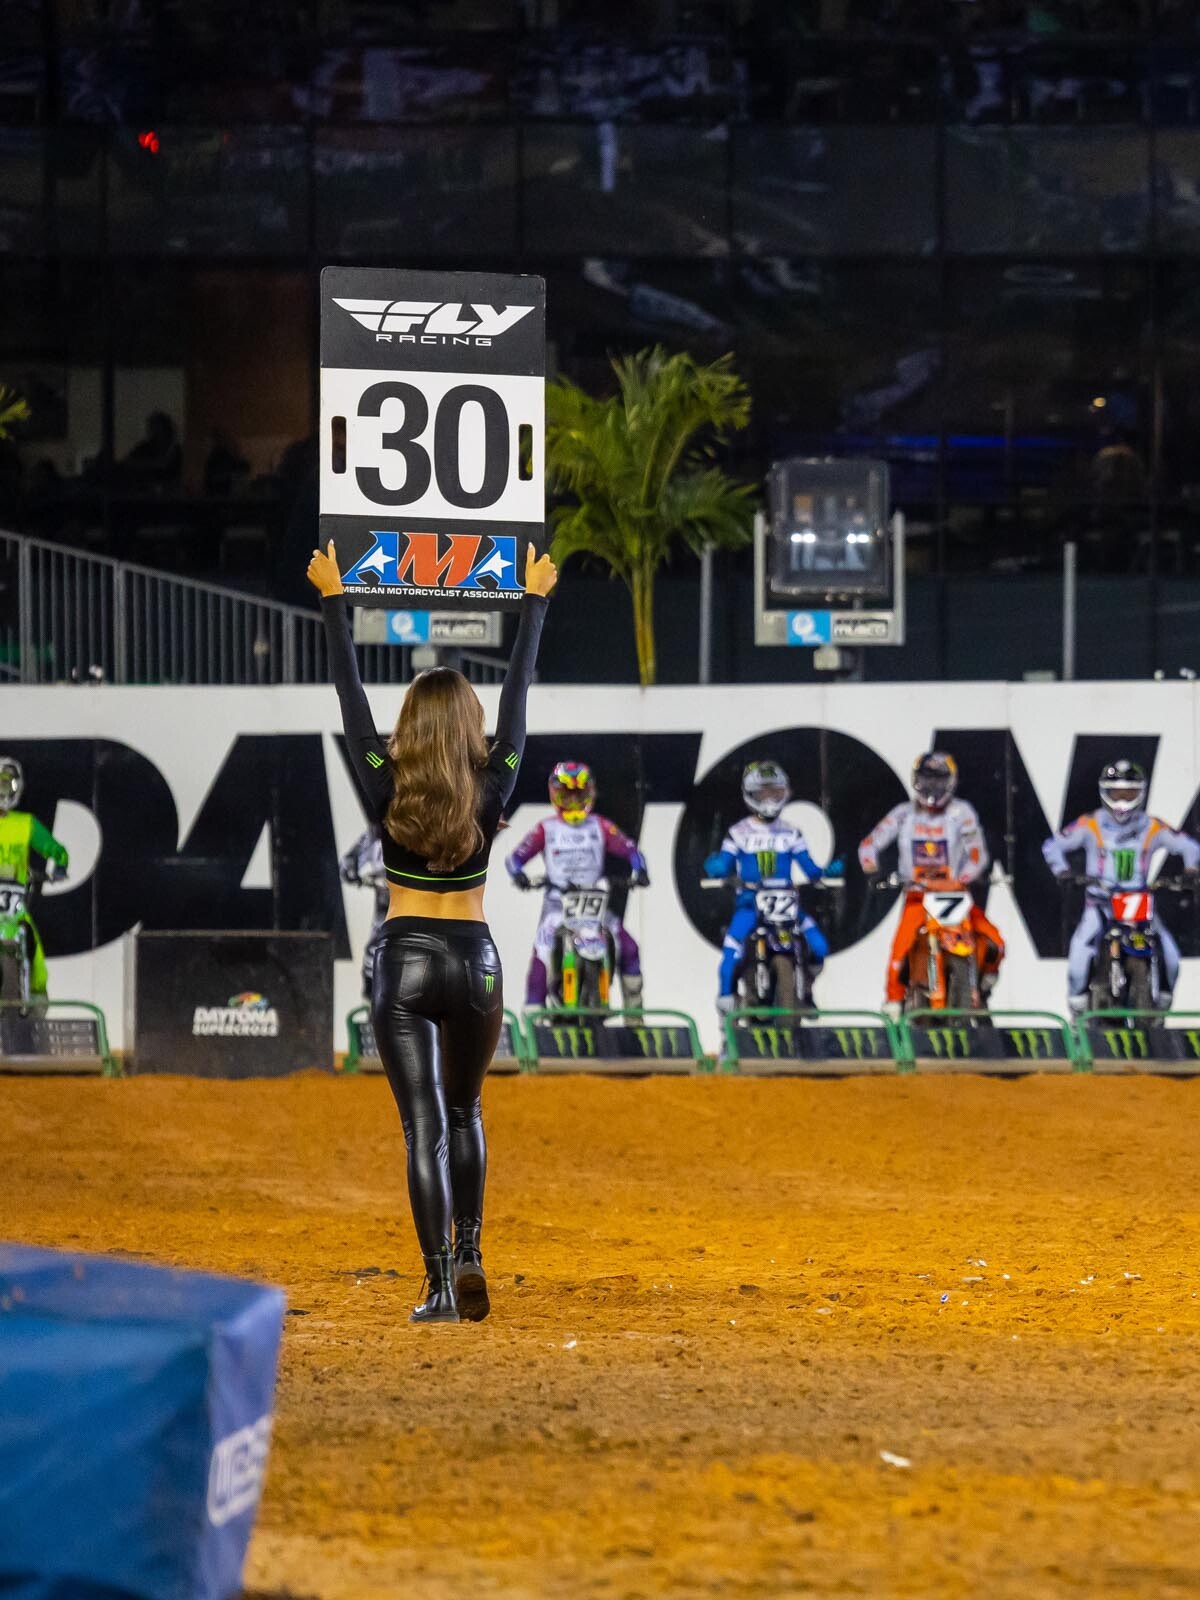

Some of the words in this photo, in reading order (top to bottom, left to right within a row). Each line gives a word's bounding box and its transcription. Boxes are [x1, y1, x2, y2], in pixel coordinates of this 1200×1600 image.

[381, 299, 536, 336] FLY
[375, 333, 493, 347] RACING
[355, 381, 510, 510] 30
[341, 530, 527, 591] AMA
[343, 585, 385, 595] MERICAN
[386, 586, 461, 598] MOTORCYCLIST
[566, 896, 603, 919] 219
[935, 897, 964, 919] 7
[1122, 893, 1143, 920] 1
